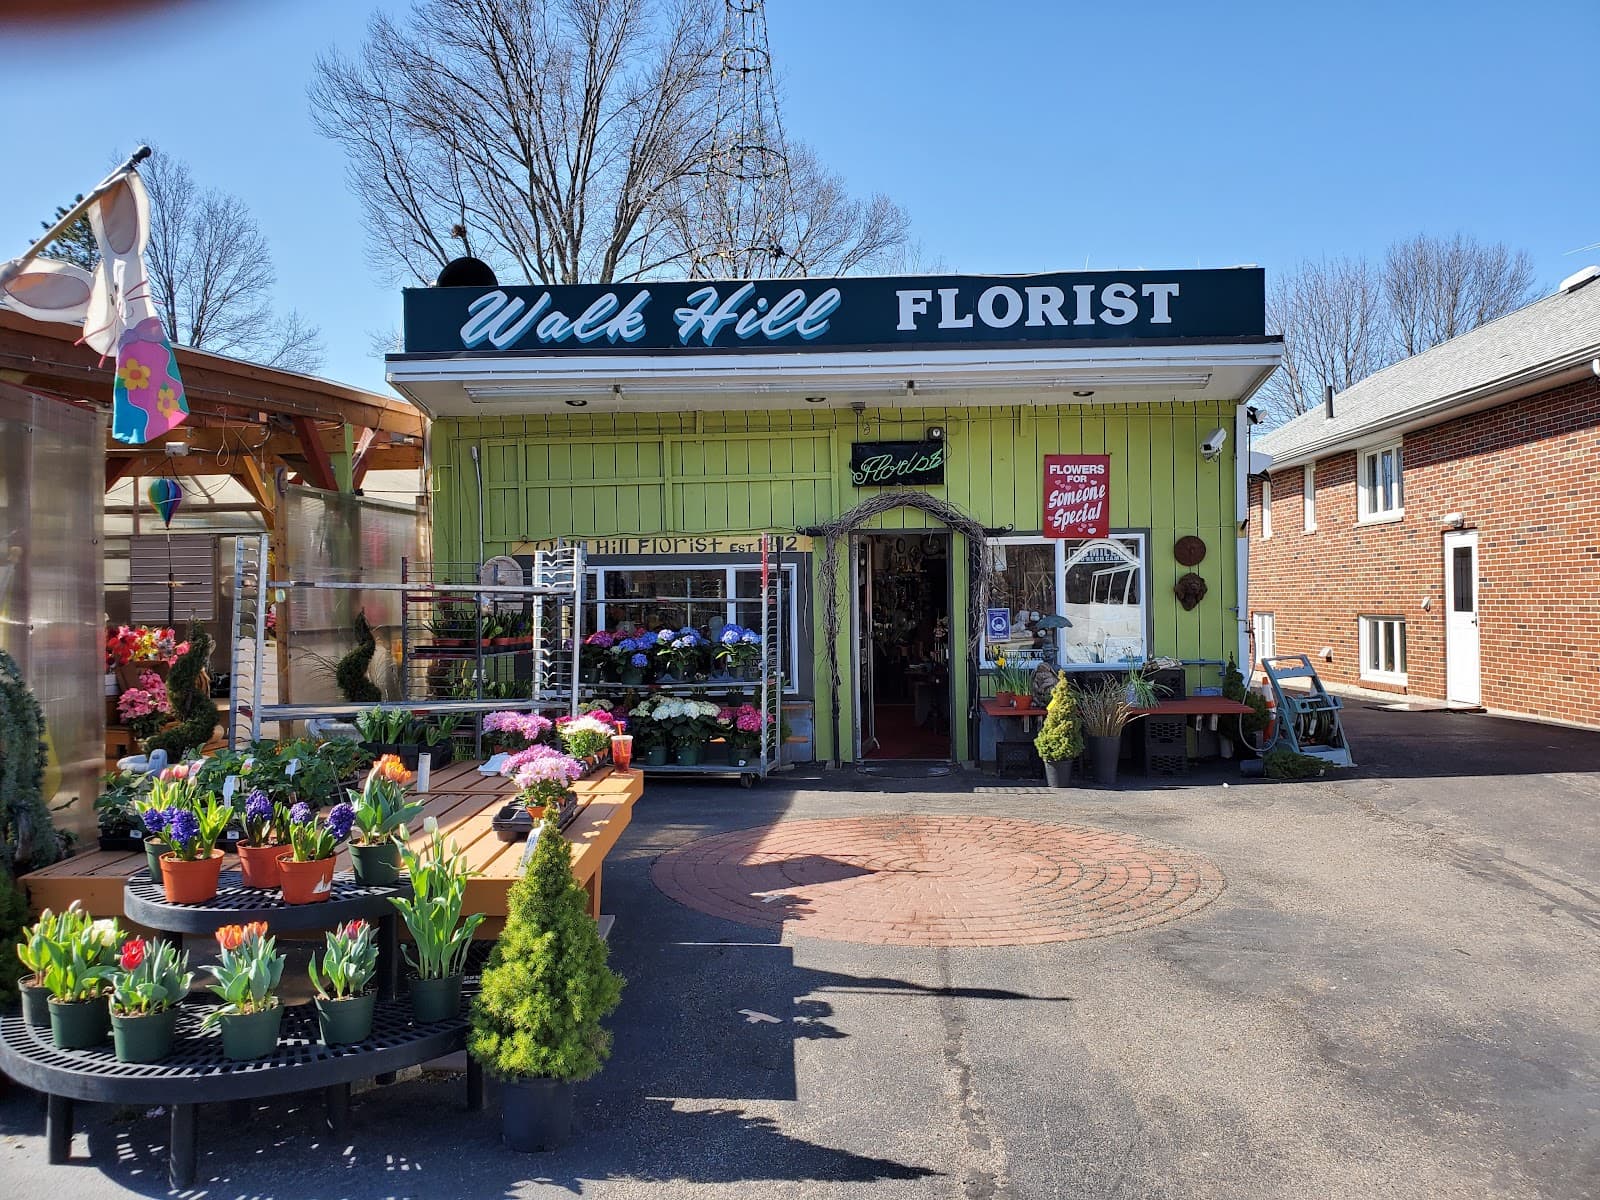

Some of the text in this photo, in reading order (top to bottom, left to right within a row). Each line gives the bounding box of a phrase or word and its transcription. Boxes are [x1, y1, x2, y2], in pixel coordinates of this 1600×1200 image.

[460, 281, 1180, 350] Walk Hill FLORIST
[1049, 464, 1105, 475] FLOWERS
[1066, 475, 1088, 483] FOR
[1047, 484, 1106, 509] Someone
[1052, 500, 1103, 532] Special
[596, 537, 629, 554] Hill
